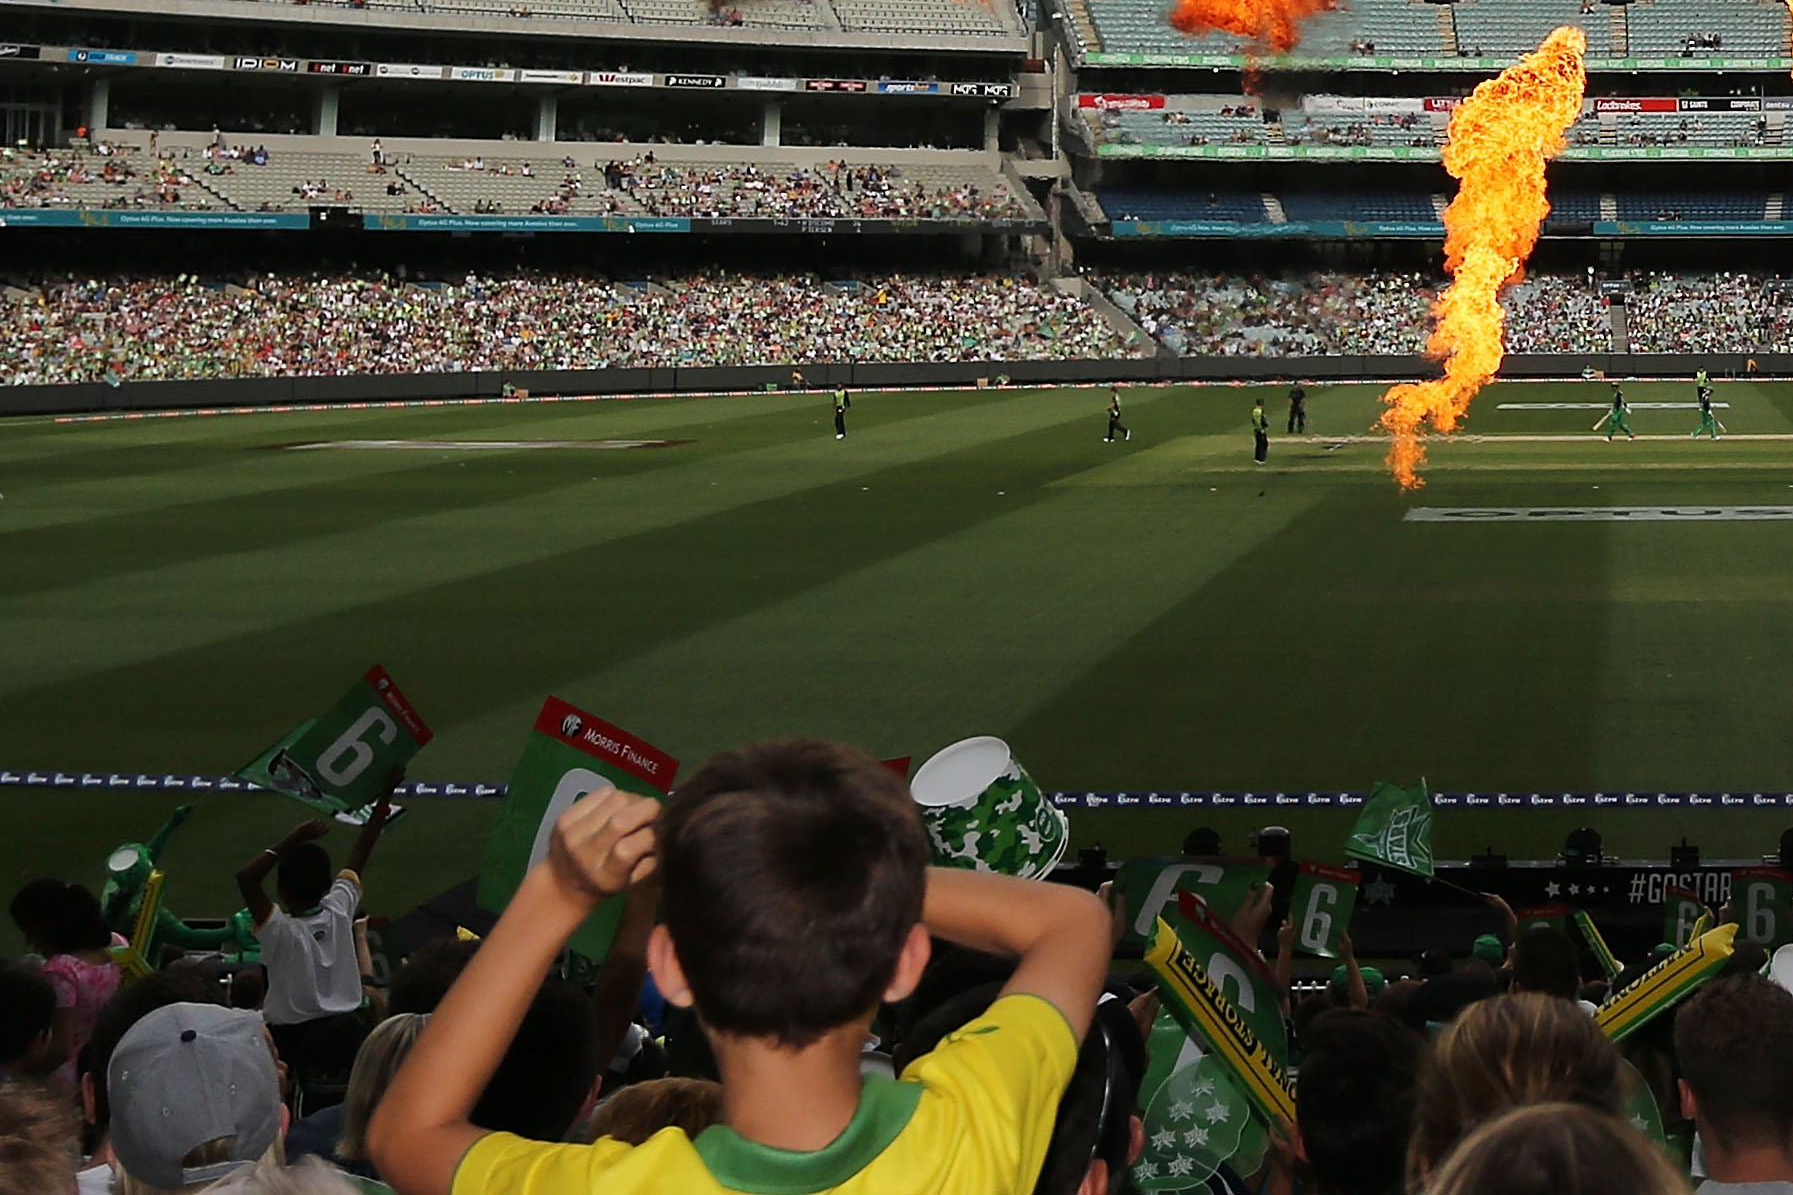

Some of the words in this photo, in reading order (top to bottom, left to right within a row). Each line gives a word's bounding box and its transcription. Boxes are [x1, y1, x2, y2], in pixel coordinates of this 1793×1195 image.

[236, 58, 296, 71] IDIOM
[461, 70, 494, 80] OPTUS
[598, 73, 646, 84] Westpac
[678, 78, 713, 86] KENNEDY
[316, 705, 399, 787] 6
[583, 727, 621, 756] MORRIS
[621, 745, 660, 775] FINANCE
[1300, 883, 1338, 950] 6
[1747, 881, 1776, 943] 6
